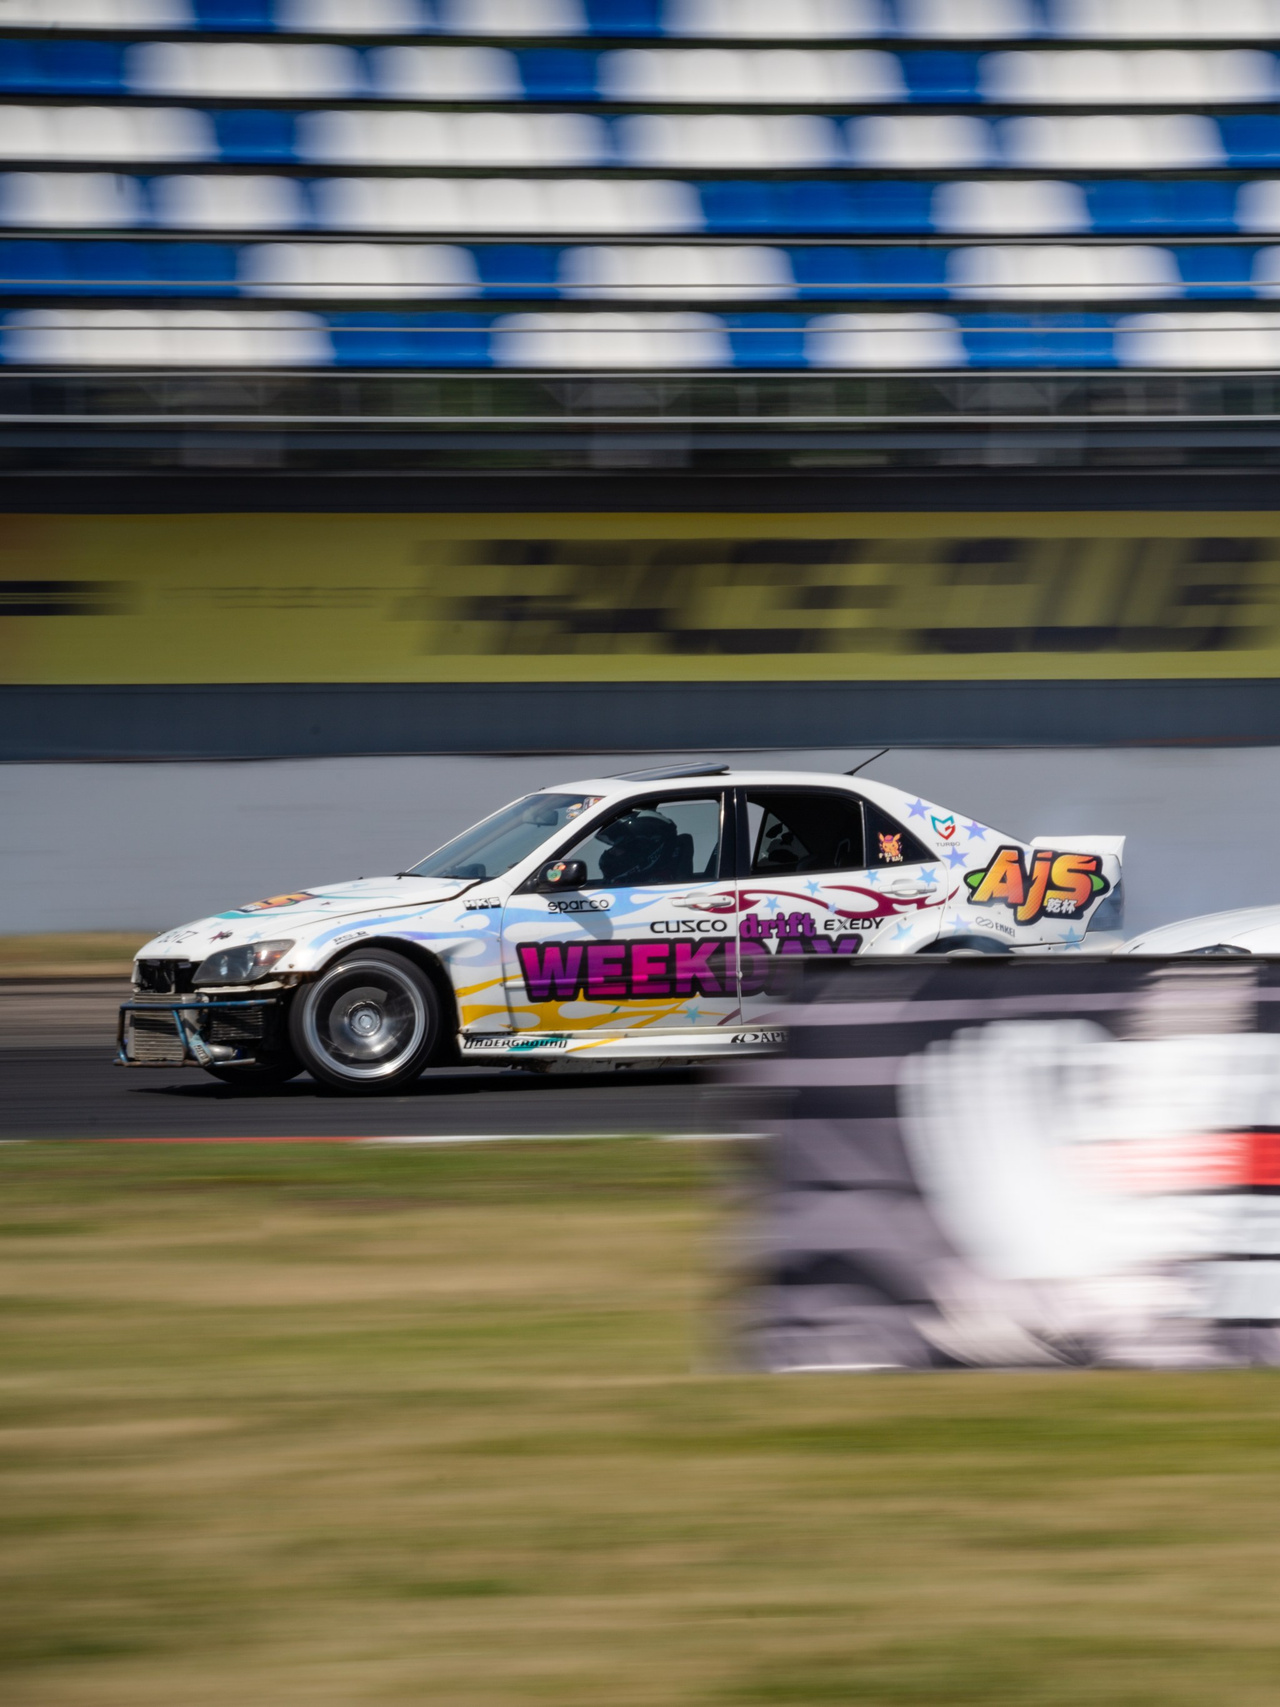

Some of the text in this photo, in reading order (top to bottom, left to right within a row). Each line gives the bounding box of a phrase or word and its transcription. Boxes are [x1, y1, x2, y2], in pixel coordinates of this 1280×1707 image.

[463, 897, 501, 911] HKS
[547, 899, 611, 914] sparco
[650, 919, 727, 933] CUSCO
[739, 912, 817, 938] drift
[823, 918, 884, 932] EXEDY
